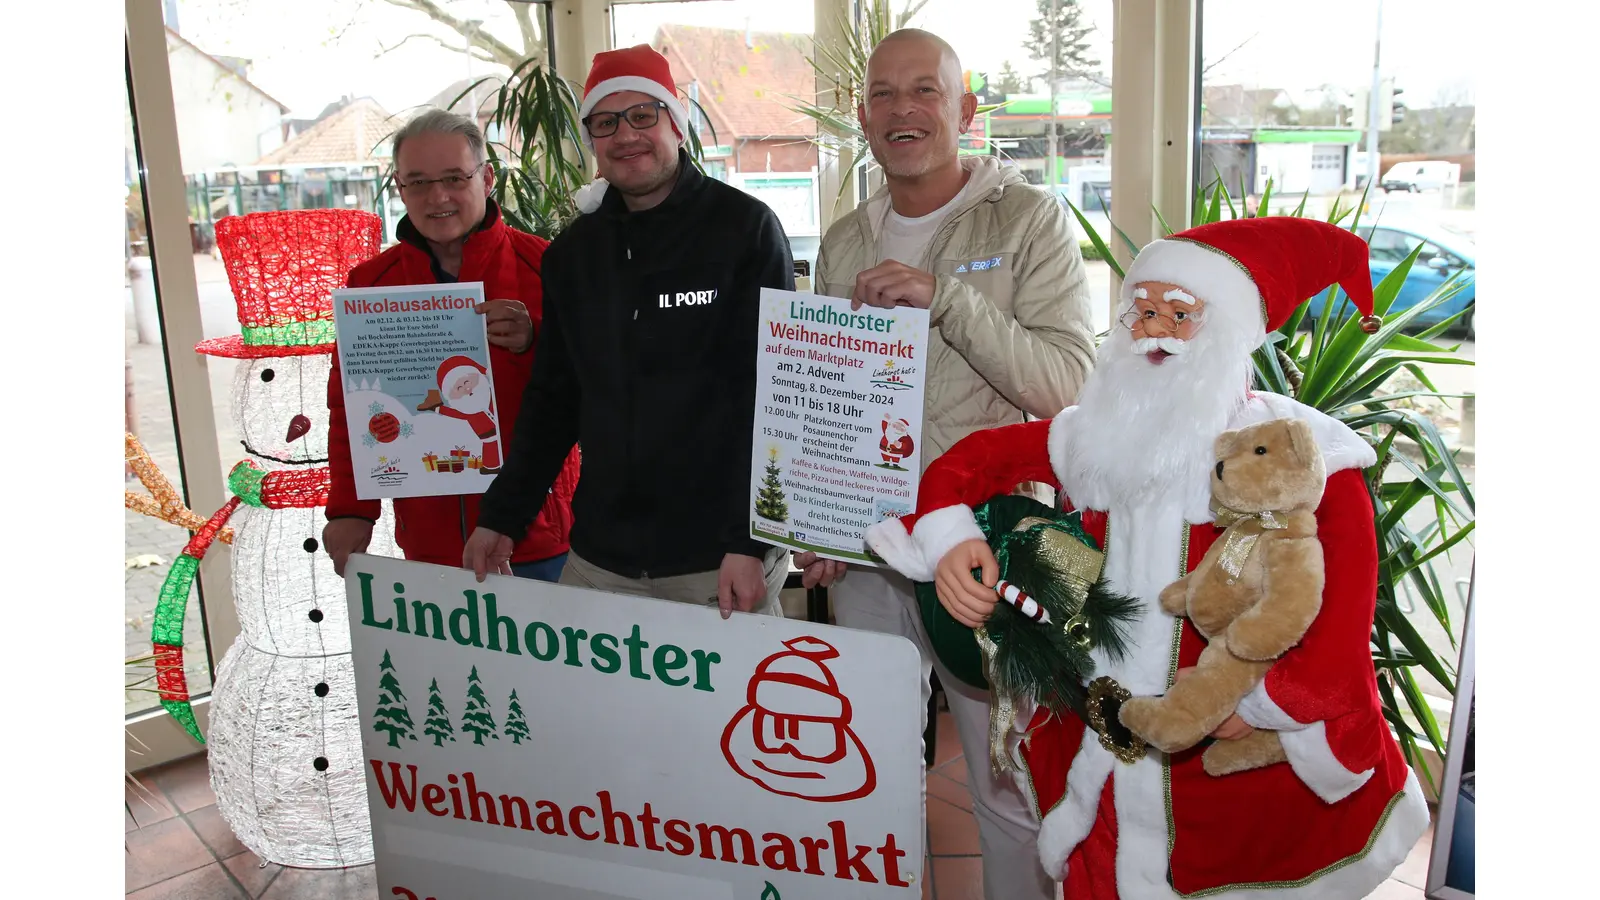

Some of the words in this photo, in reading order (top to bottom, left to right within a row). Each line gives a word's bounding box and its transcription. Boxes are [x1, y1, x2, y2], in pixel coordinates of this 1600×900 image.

[344, 295, 476, 315] Nikolausaktion
[659, 294, 672, 308] IL
[676, 288, 717, 306] PORT
[790, 301, 895, 333] Lindhorster
[352, 342, 400, 350] EDEKA-Kappe
[770, 321, 914, 359] Weihnachtsmarkt
[766, 343, 782, 353] auf
[784, 344, 805, 358] dem
[808, 349, 864, 368] Marktplatz
[777, 362, 793, 373] am
[796, 363, 805, 375] 2.
[807, 366, 846, 382] Advent
[872, 368, 900, 378] Lindhorst
[772, 375, 808, 392] Sonntag,
[810, 383, 818, 393] 8.
[820, 384, 867, 401] Dezember
[868, 393, 894, 406] 2024
[764, 405, 785, 417] 12.00
[786, 410, 800, 420] Uhr
[772, 393, 791, 405] von
[794, 396, 805, 408] 11
[808, 398, 824, 412] bis
[827, 402, 840, 414] 18
[843, 404, 864, 418] Uhr
[802, 424, 858, 443] Posaunenchor
[804, 414, 853, 430] Platzkonzert
[854, 424, 873, 434] vom
[763, 427, 784, 438] 15.30
[785, 432, 798, 442] Uhr
[802, 436, 838, 451] erscheint
[839, 442, 854, 453] der
[802, 446, 870, 467] Weihnachtsmann
[791, 458, 812, 469] Kaffee
[820, 464, 847, 476] Kuchen,
[849, 469, 879, 482] Waffeln,
[880, 475, 910, 487] Wildge-
[784, 479, 874, 504] Weihnachtsbaumverkauf
[789, 468, 810, 480] richte,
[811, 473, 829, 484] Pizza
[830, 477, 844, 487] und
[844, 480, 875, 492] leckeres
[876, 487, 893, 495] vom
[893, 489, 910, 498] Grill
[793, 493, 807, 504] Das
[808, 494, 873, 517] Kinderkarussell
[808, 510, 830, 522] dreht
[793, 518, 853, 538] Weihnachtliches
[357, 572, 722, 692] Lindhorster
[369, 759, 910, 888] Weihnachtsmarkt
